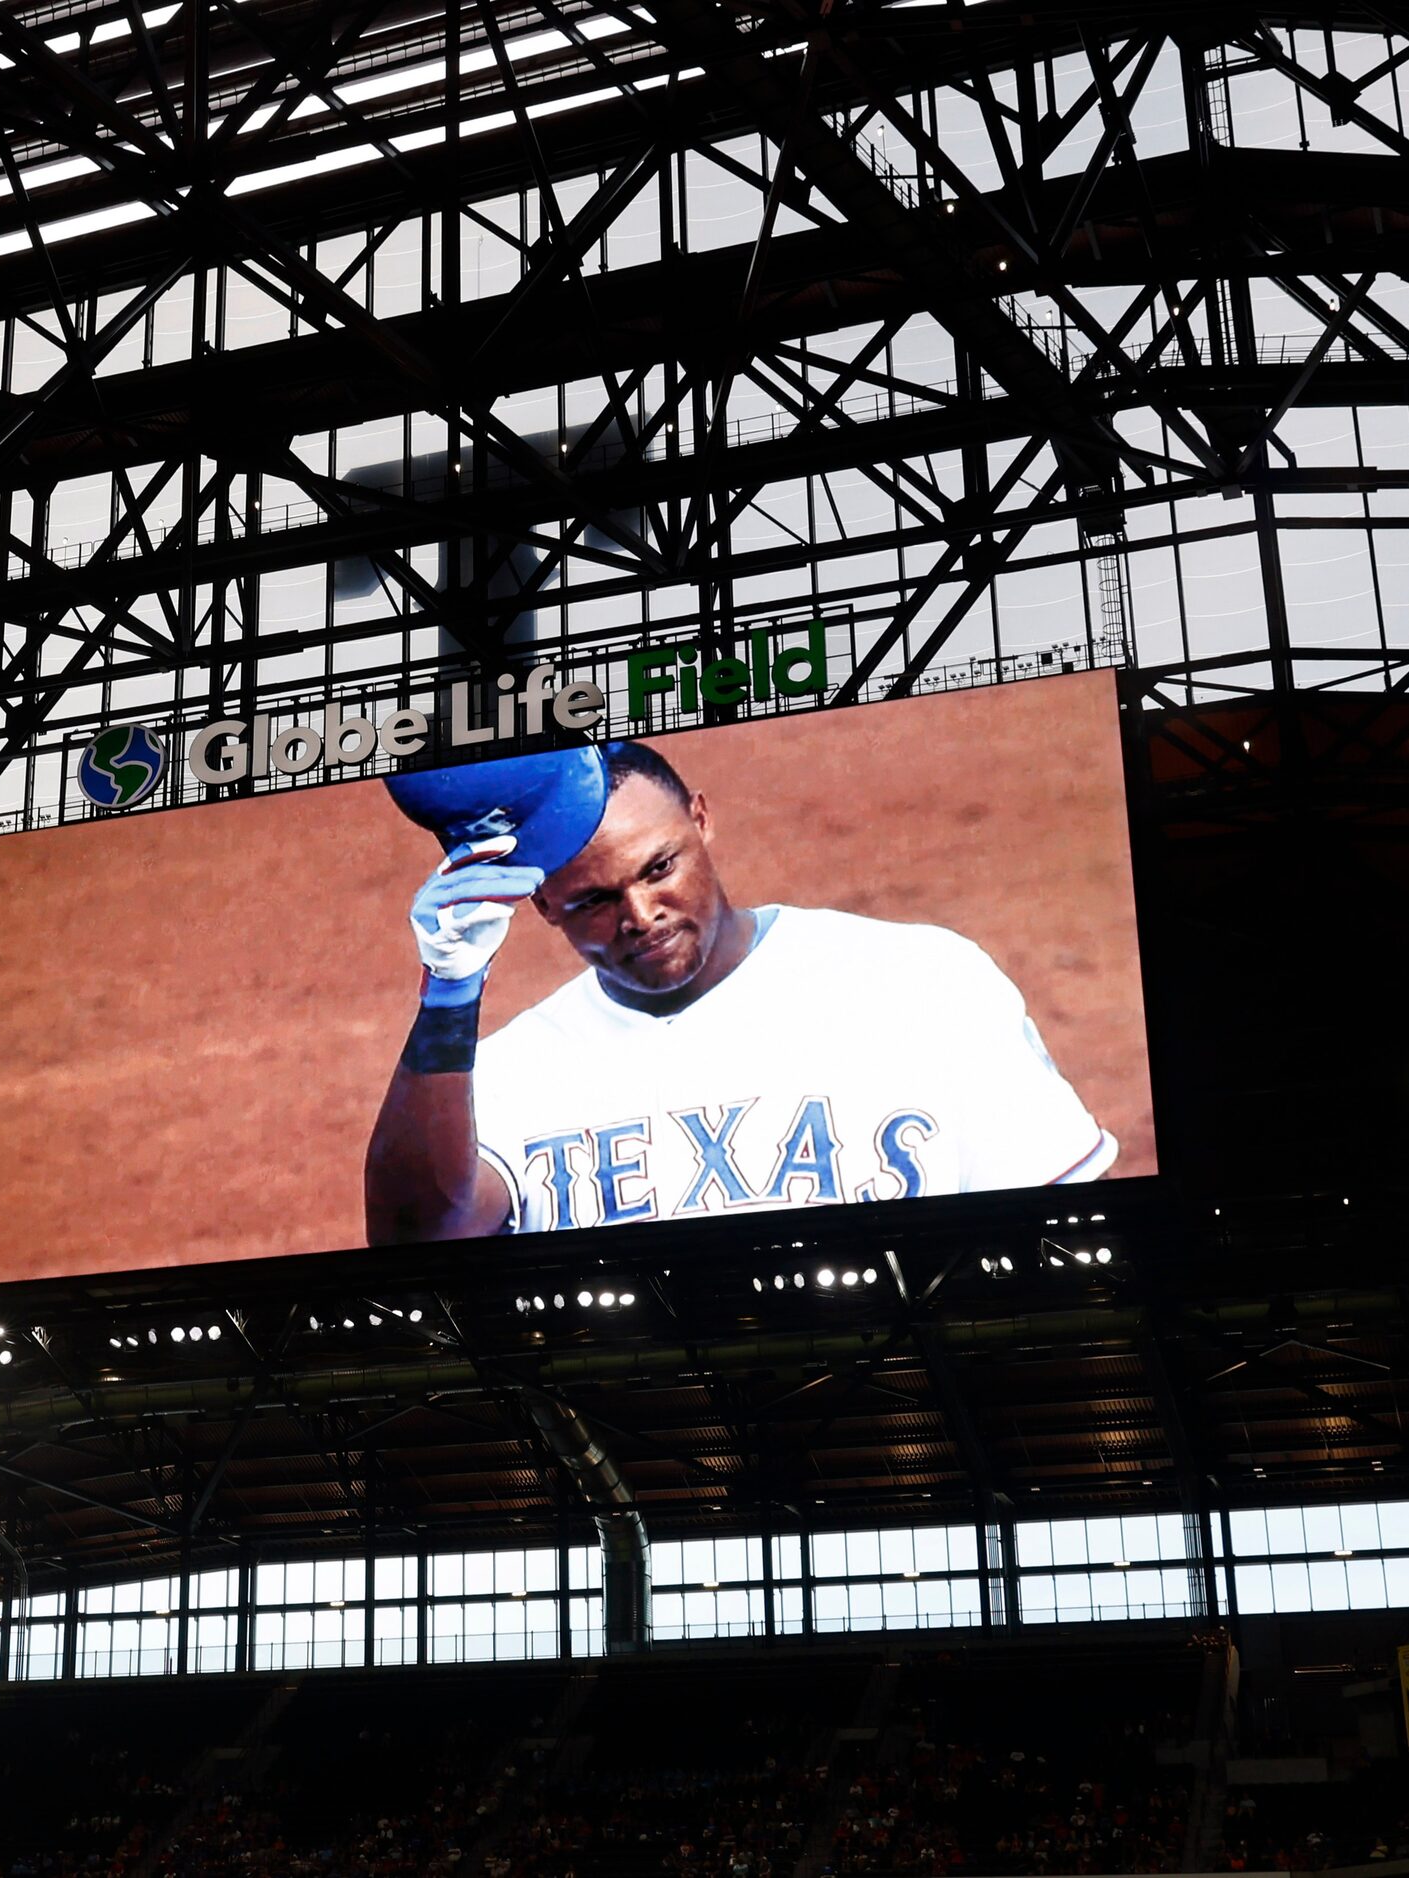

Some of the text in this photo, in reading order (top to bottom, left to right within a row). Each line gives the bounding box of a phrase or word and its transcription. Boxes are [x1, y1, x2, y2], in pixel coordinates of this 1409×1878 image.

[189, 618, 829, 786] Globe Life Field
[523, 1094, 940, 1231] TEXAS
